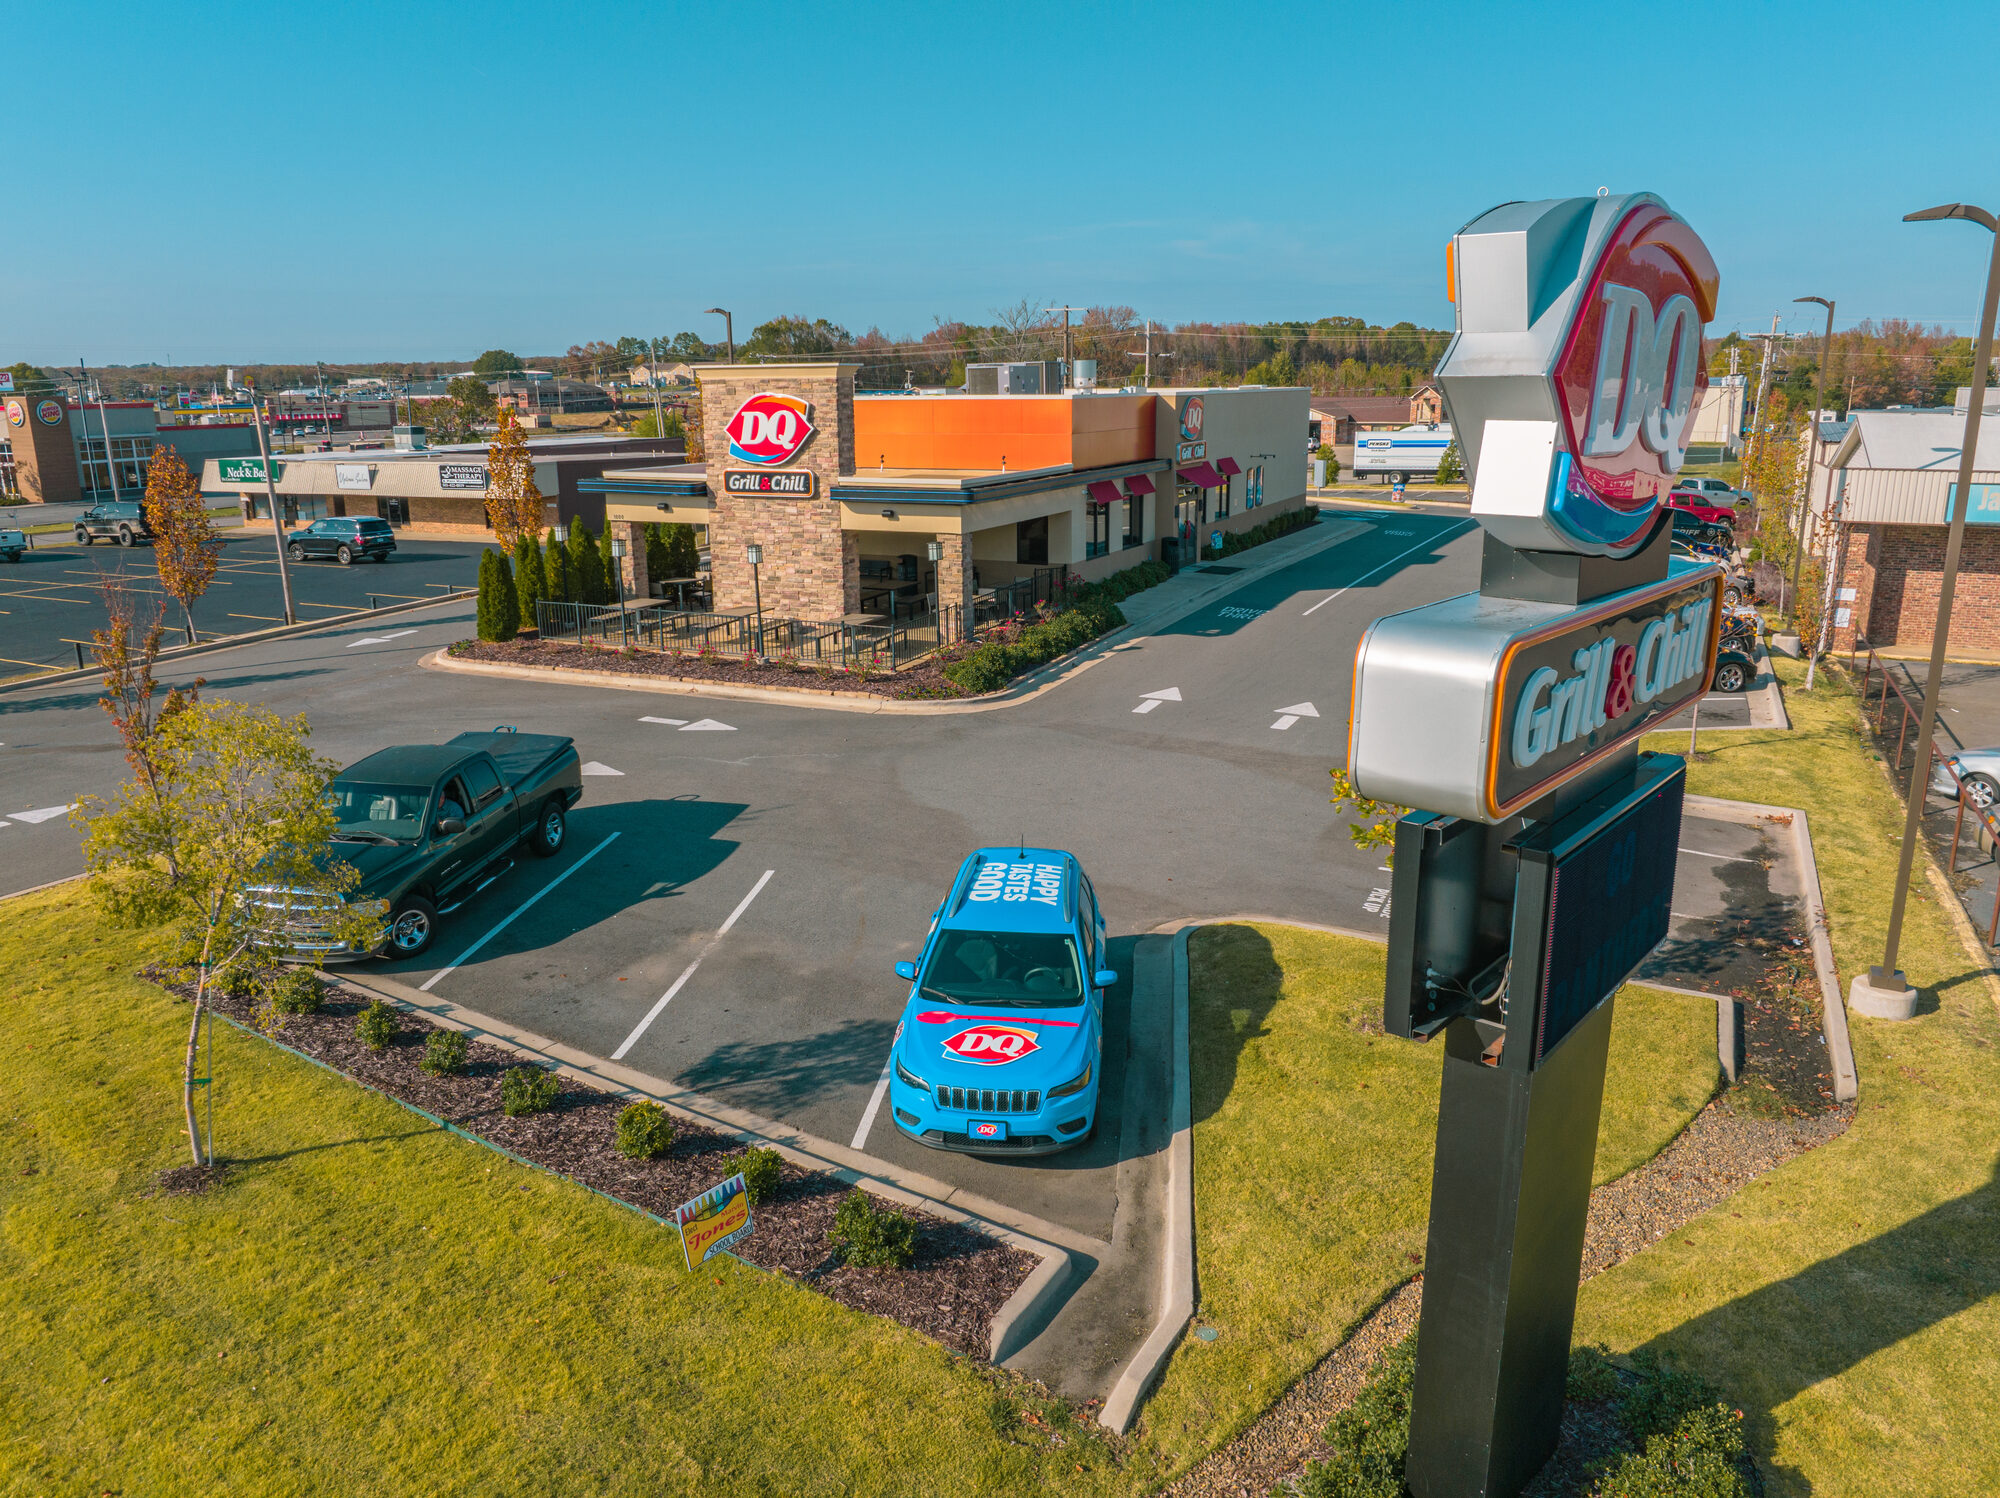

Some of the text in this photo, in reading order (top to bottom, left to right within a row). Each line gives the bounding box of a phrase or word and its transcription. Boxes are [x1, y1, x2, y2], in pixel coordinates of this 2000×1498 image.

[1582, 281, 1701, 474] DQ
[42, 410, 60, 418] KING
[1188, 408, 1202, 430] DQ
[740, 410, 796, 449] DQ
[227, 467, 266, 477] Neck & Bac
[1218, 611, 1264, 619] THRU
[1221, 606, 1270, 614] DRIVE
[1512, 598, 1712, 768] Grill&Chill
[969, 862, 1008, 901] GOOD
[1003, 863, 1034, 902] TASTES
[1030, 864, 1062, 906] HAPPY
[1366, 888, 1390, 903] PICK
[1362, 902, 1382, 912] UP
[958, 1034, 1024, 1056] DQ
[721, 1202, 744, 1218] Marvin
[685, 1210, 746, 1250] Elect Jones
[709, 1224, 752, 1256] SCHOOL BOARD
